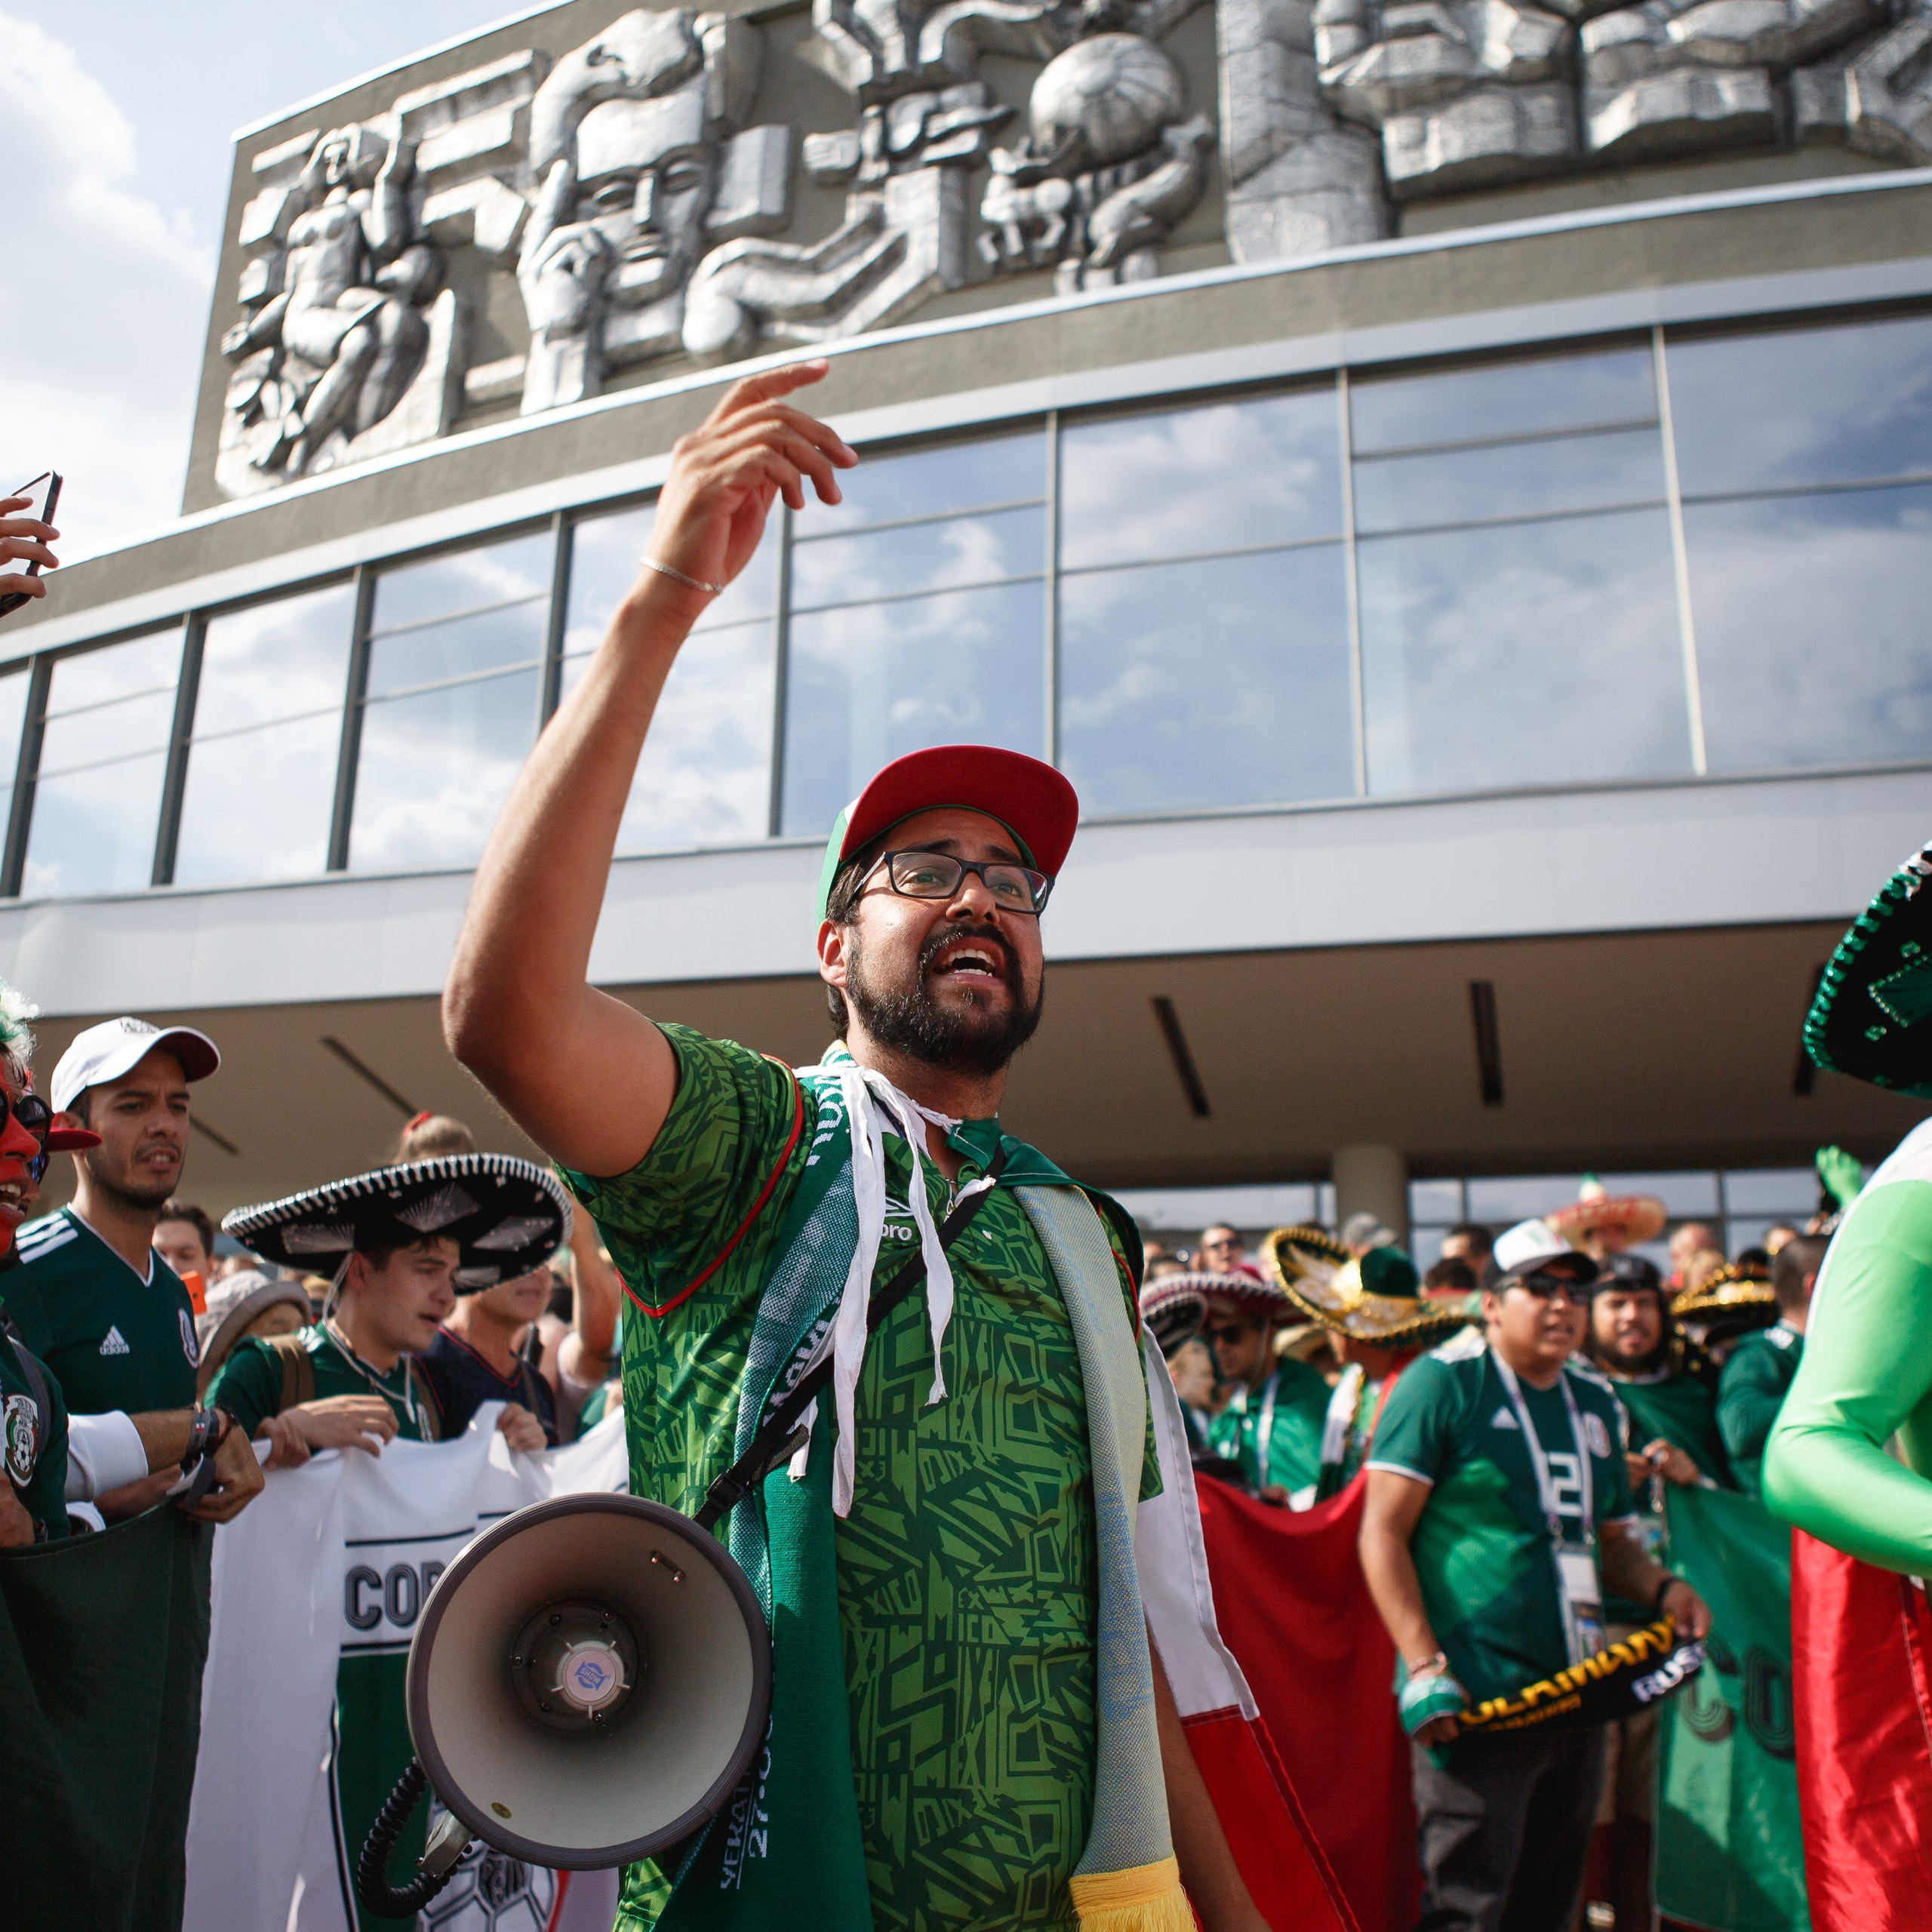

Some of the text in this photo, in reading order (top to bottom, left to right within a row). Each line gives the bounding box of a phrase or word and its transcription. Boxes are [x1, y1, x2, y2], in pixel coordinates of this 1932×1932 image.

[99, 1343, 130, 1356] adidas
[720, 1767, 752, 1889] YEKAT
[748, 1713, 773, 1858] 27.0
